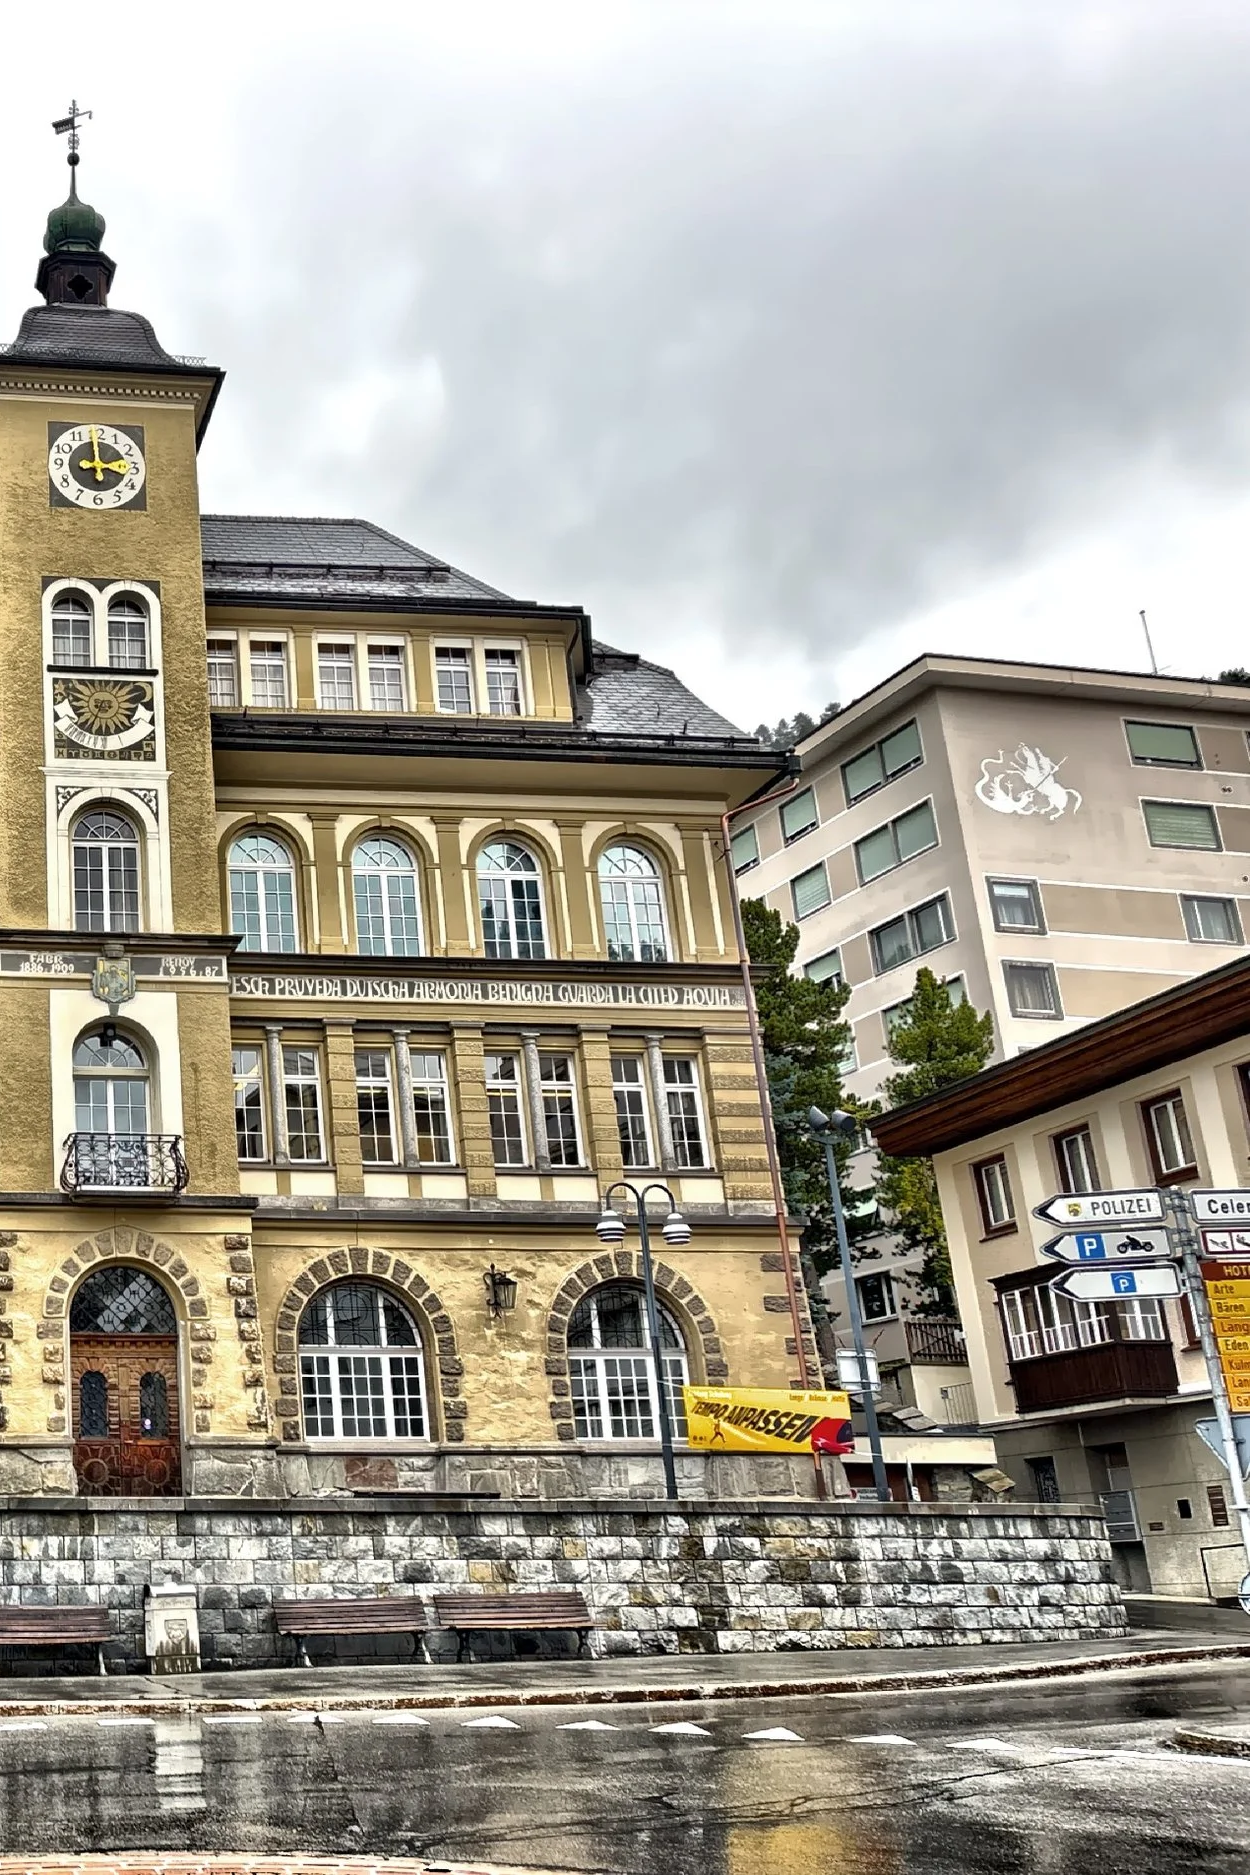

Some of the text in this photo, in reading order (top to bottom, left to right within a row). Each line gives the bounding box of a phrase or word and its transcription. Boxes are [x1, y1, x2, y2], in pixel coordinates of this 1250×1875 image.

[70, 431, 83, 441] 11
[111, 433, 119, 444] 1
[54, 443, 72, 454] 10
[123, 444, 133, 456] 2
[54, 458, 63, 470] 9
[130, 462, 139, 475] 3
[60, 474, 69, 488] 8
[125, 478, 136, 490] 4
[75, 488, 84, 500] 7
[93, 493, 103, 506] 6
[113, 490, 123, 503] 5
[558, 984, 615, 1004] GUARDA
[619, 985, 636, 1005] LA
[1091, 1198, 1152, 1216] POLIZEI
[1083, 1238, 1097, 1256] P
[1222, 1265, 1250, 1276] HOT
[1119, 1279, 1130, 1292] P
[1214, 1284, 1235, 1295] Arte
[1216, 1302, 1246, 1313] Bären
[1225, 1340, 1249, 1351] Eden
[1237, 1396, 1250, 1407] Sa
[691, 1401, 821, 1443] TEMPO ANPASSEN
